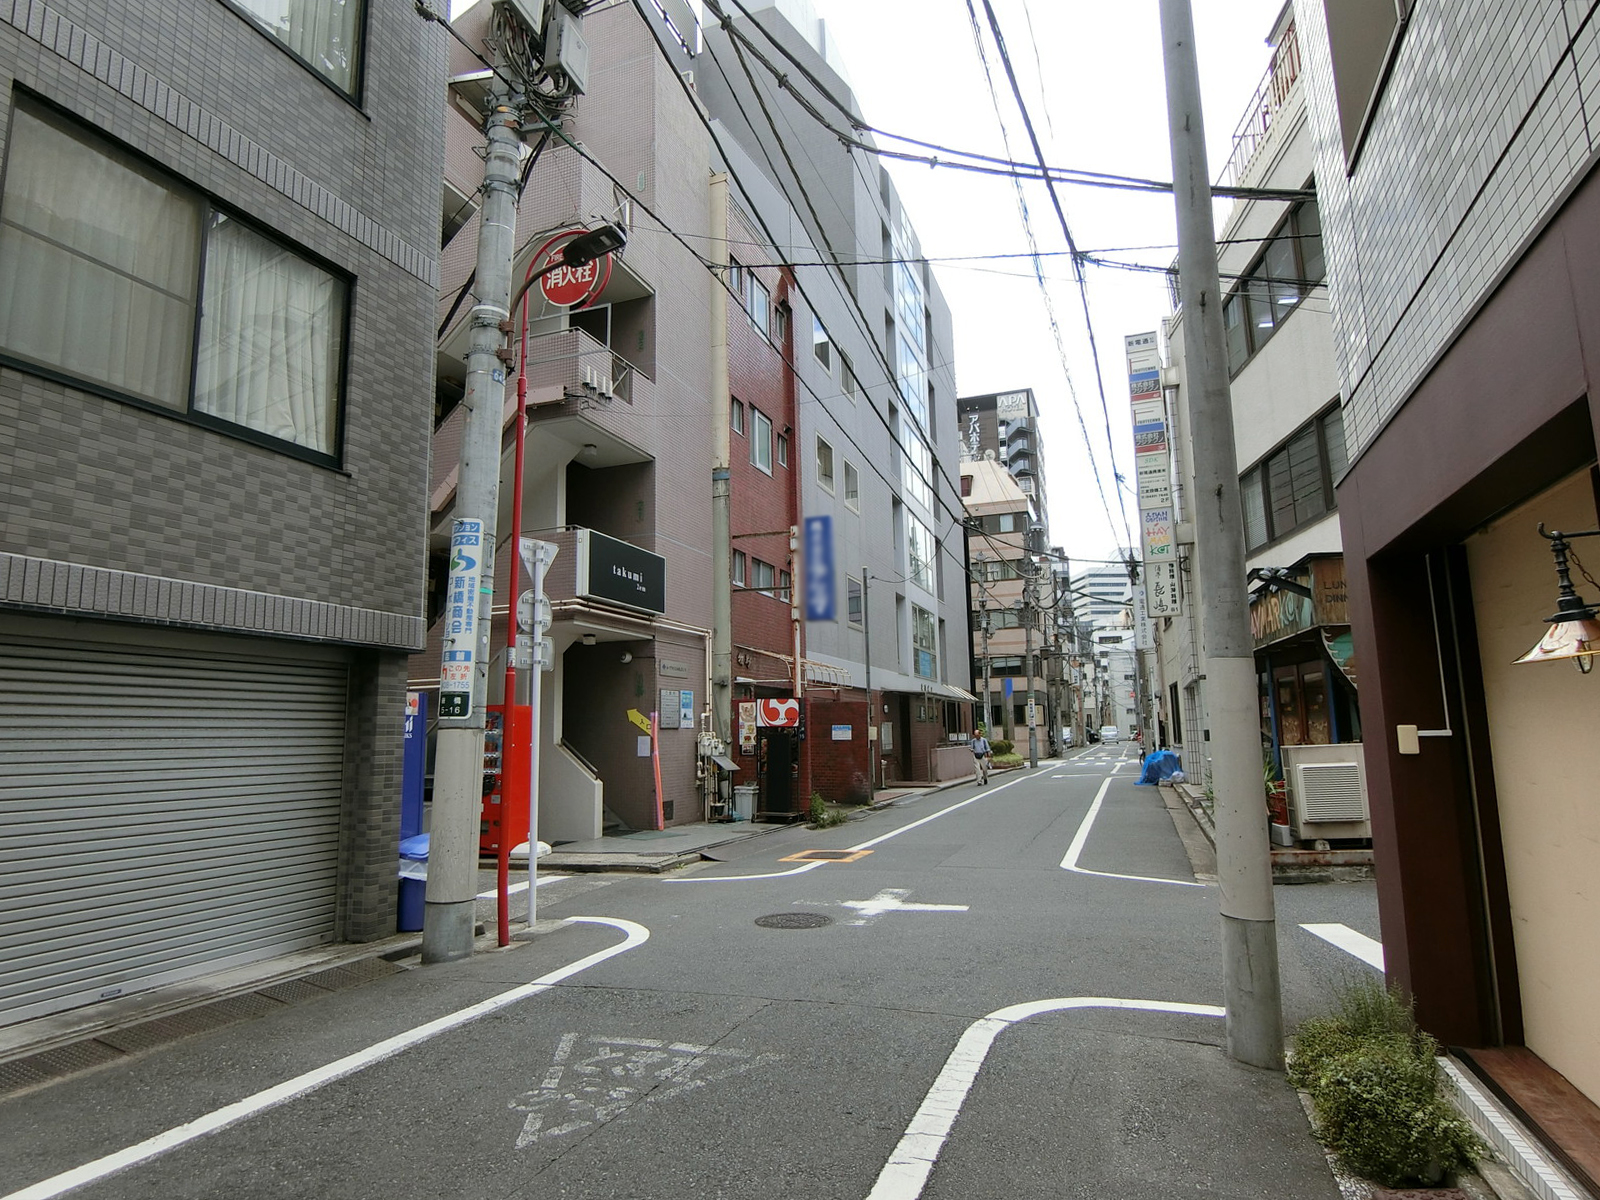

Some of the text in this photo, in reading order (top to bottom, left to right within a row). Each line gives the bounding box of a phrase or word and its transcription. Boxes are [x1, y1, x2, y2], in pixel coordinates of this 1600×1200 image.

[546, 261, 594, 290] 消火栓
[613, 564, 643, 583] takumi
[451, 576, 465, 634] 新橋商会
[448, 665, 471, 673] この先
[450, 673, 467, 681] 左折
[639, 718, 651, 730] 入口
